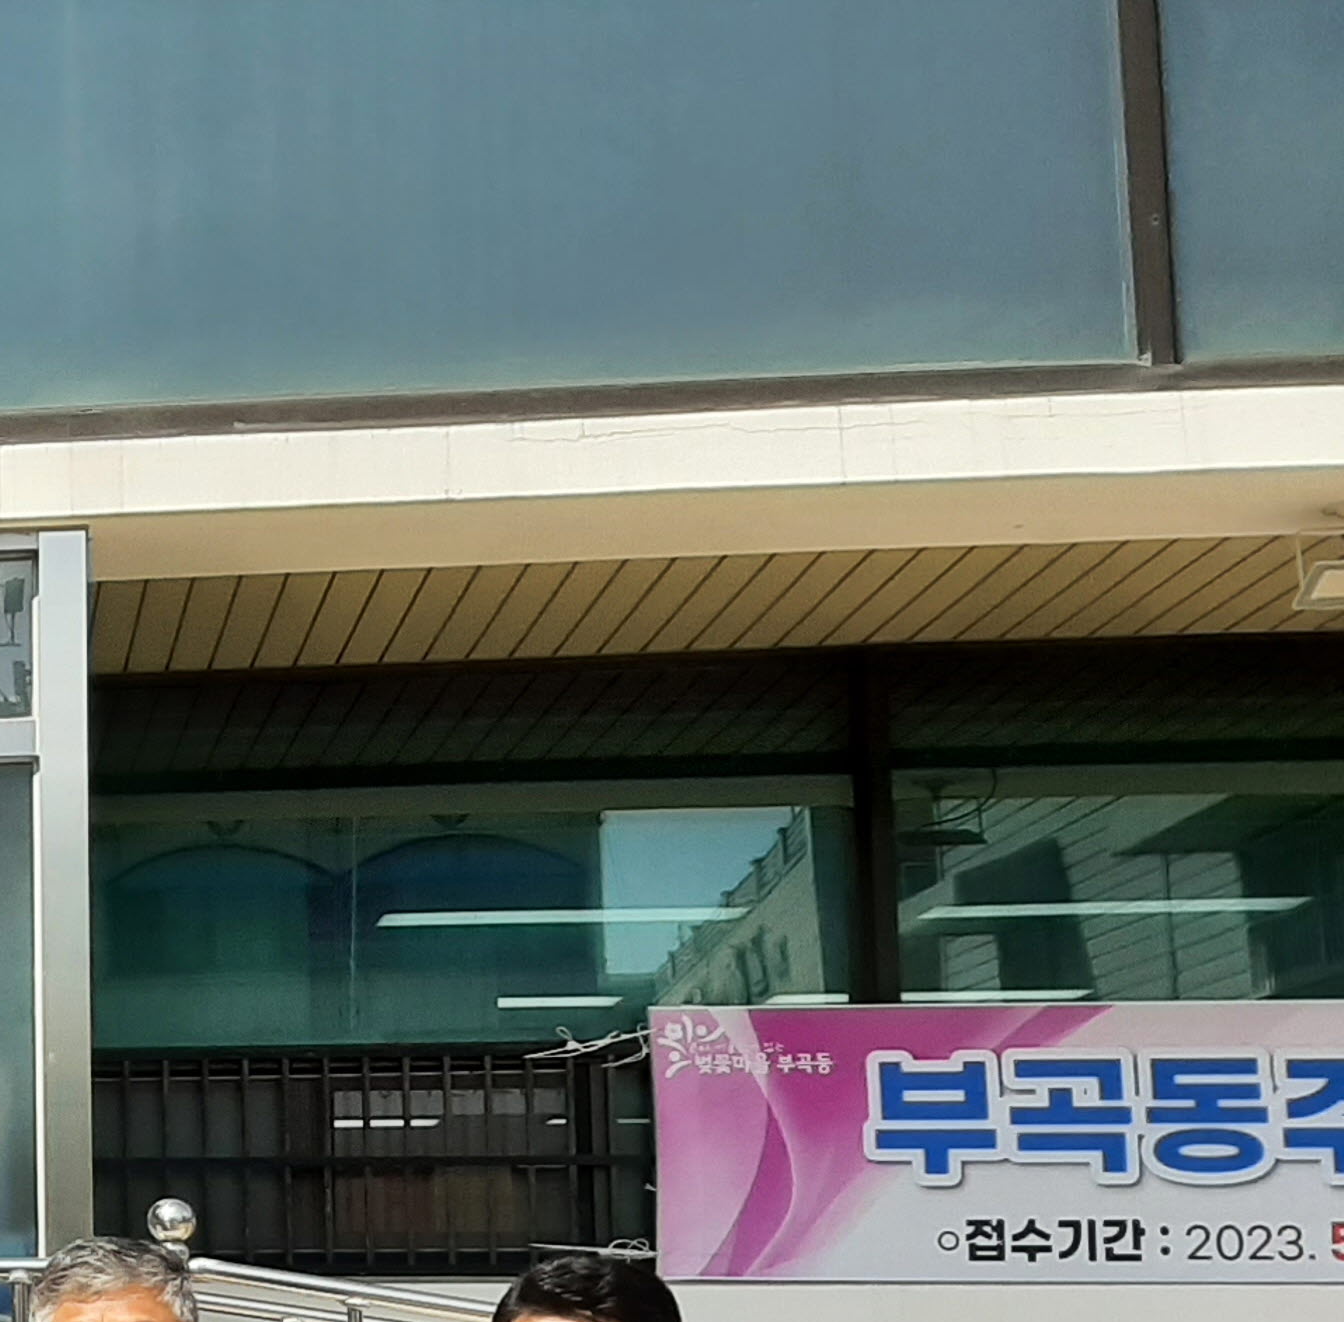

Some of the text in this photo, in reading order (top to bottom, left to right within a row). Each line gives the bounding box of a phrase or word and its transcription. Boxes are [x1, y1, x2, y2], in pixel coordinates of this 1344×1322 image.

[776, 1051, 834, 1075] 부곡동
[965, 1217, 1146, 1263] 접수기간
[1185, 1224, 1316, 1261] 2023.
